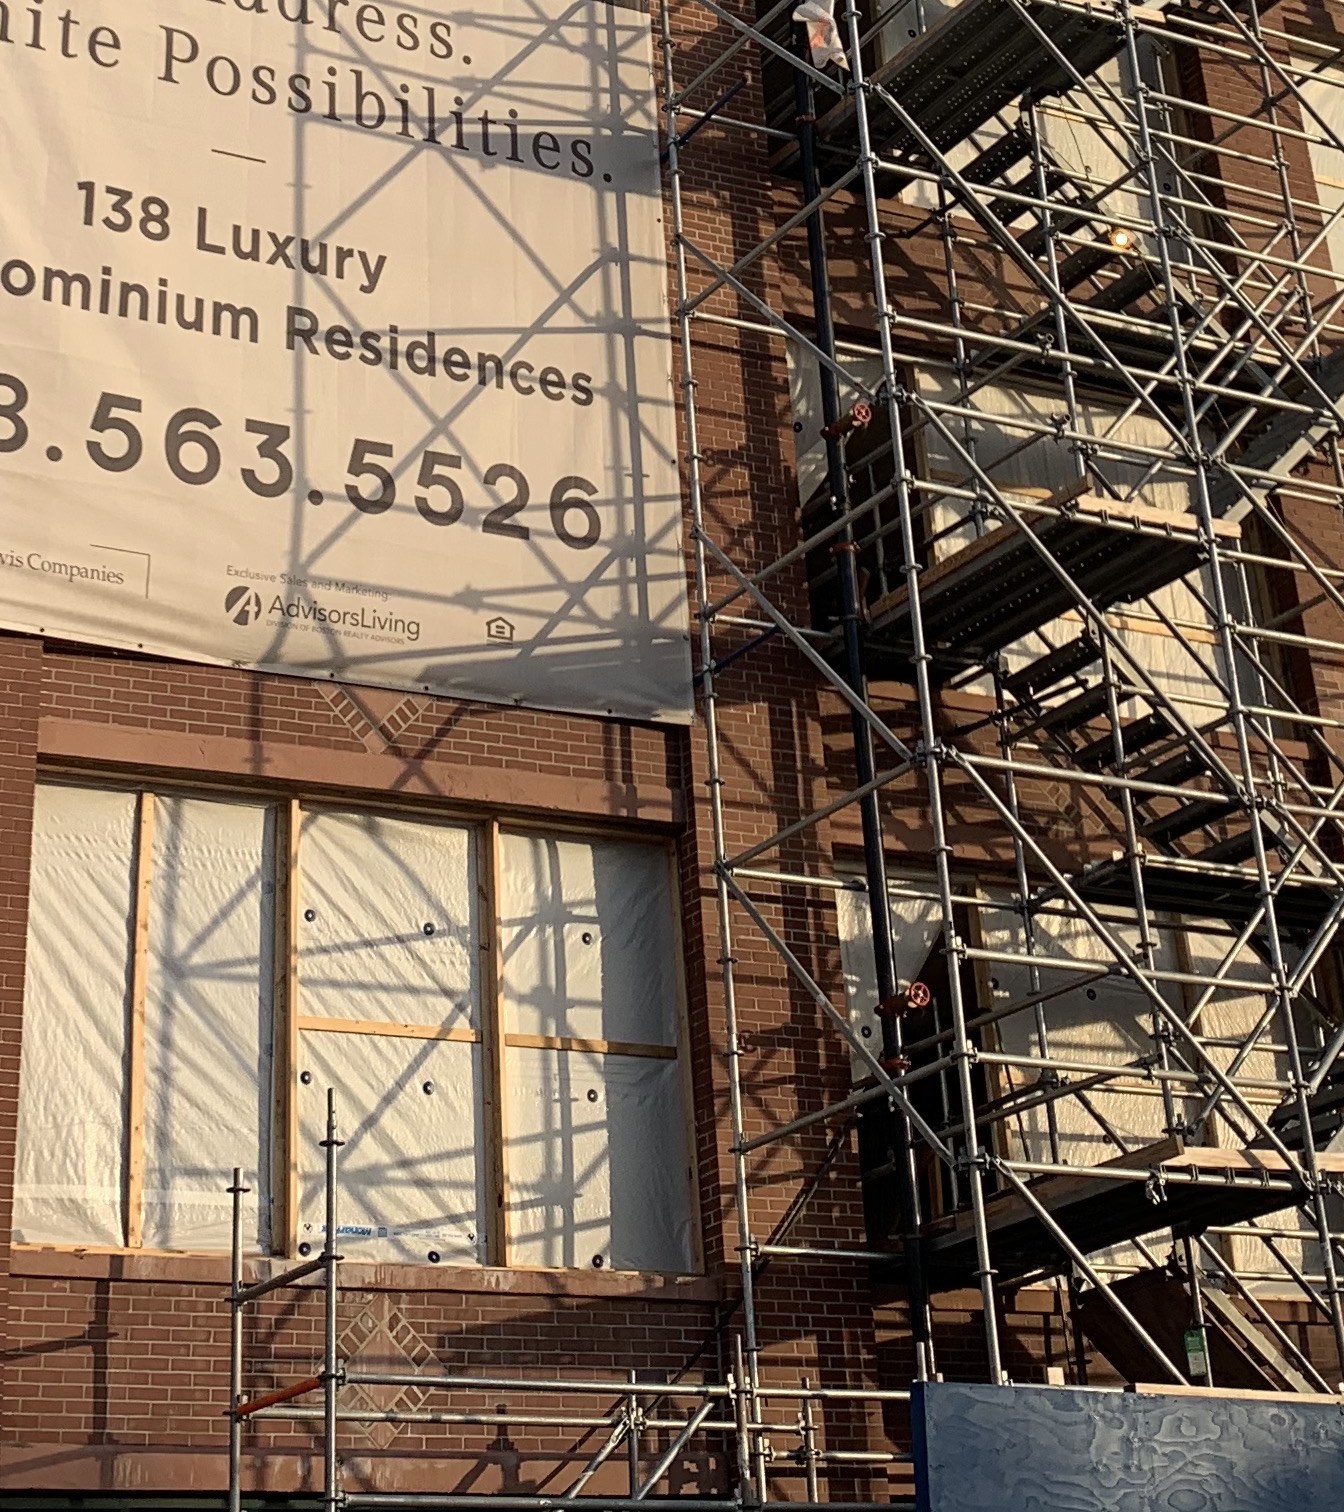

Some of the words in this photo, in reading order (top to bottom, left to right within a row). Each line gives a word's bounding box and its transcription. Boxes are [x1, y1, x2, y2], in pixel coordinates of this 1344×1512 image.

[157, 25, 613, 182] Possibilities.
[77, 181, 172, 241] 138
[197, 207, 388, 294] Luxury
[286, 306, 595, 407] Residences
[27, 553, 125, 585] Companies
[226, 565, 277, 583] Exclusive
[279, 573, 308, 588] Sales
[311, 579, 332, 592] and
